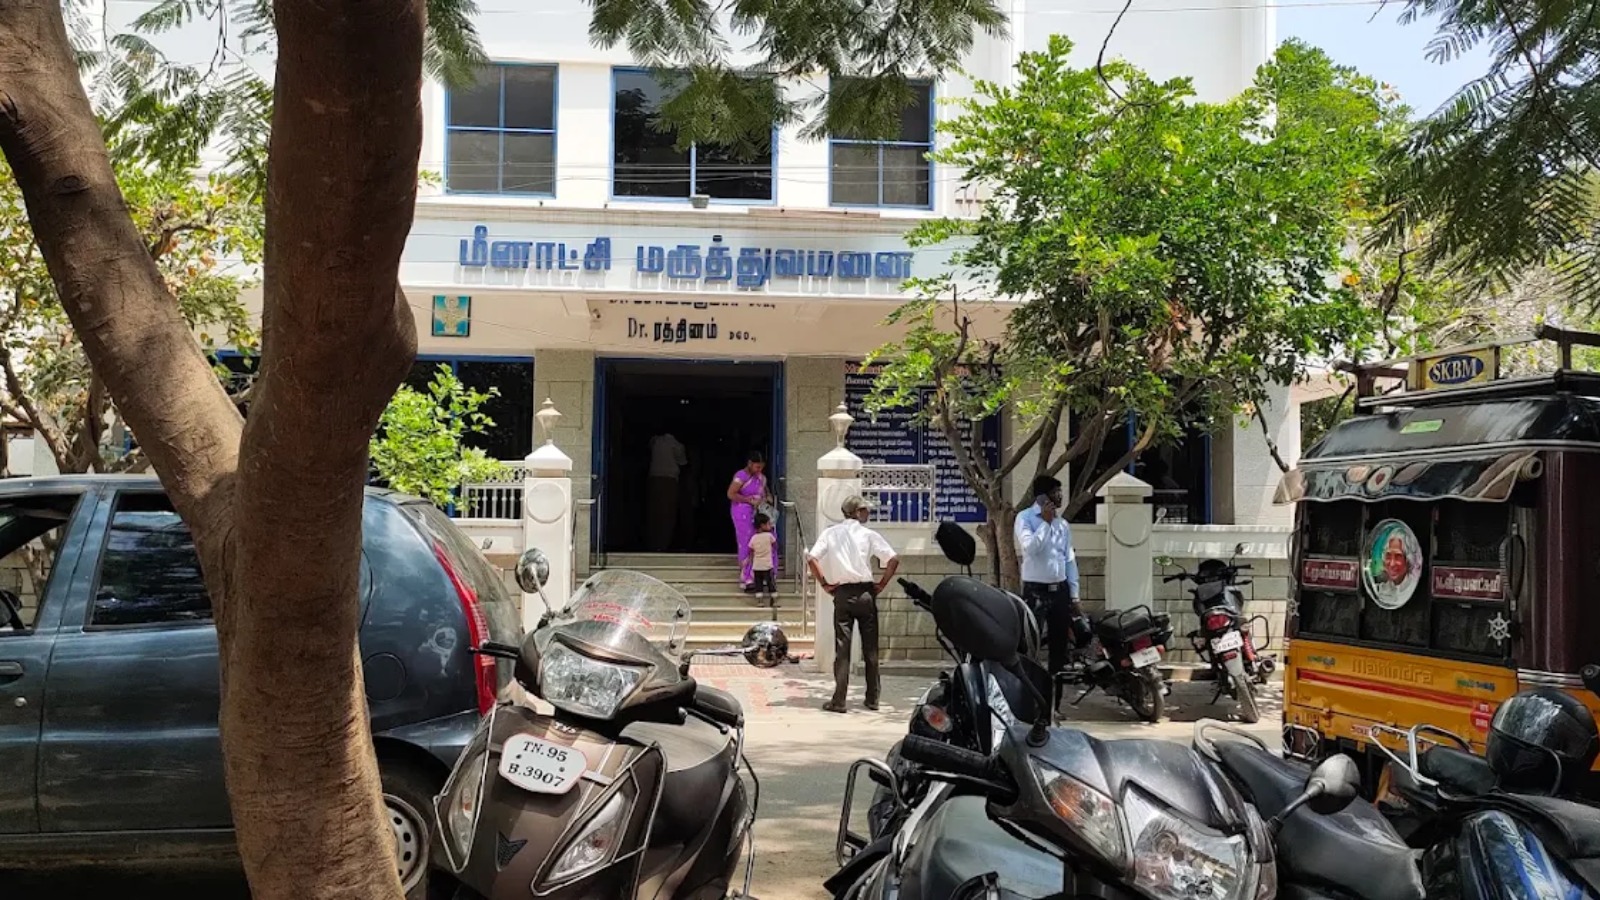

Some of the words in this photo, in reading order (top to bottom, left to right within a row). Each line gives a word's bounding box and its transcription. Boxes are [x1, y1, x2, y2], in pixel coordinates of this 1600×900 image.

[460, 225, 611, 271] மீனாட்சி
[637, 234, 915, 288] மருத்துவமனை
[628, 317, 648, 338] Dr.
[653, 317, 718, 343] ரத்தினம்
[1432, 358, 1477, 382] SKBM
[523, 741, 568, 763] TN.95
[508, 762, 565, 787] B.3907
